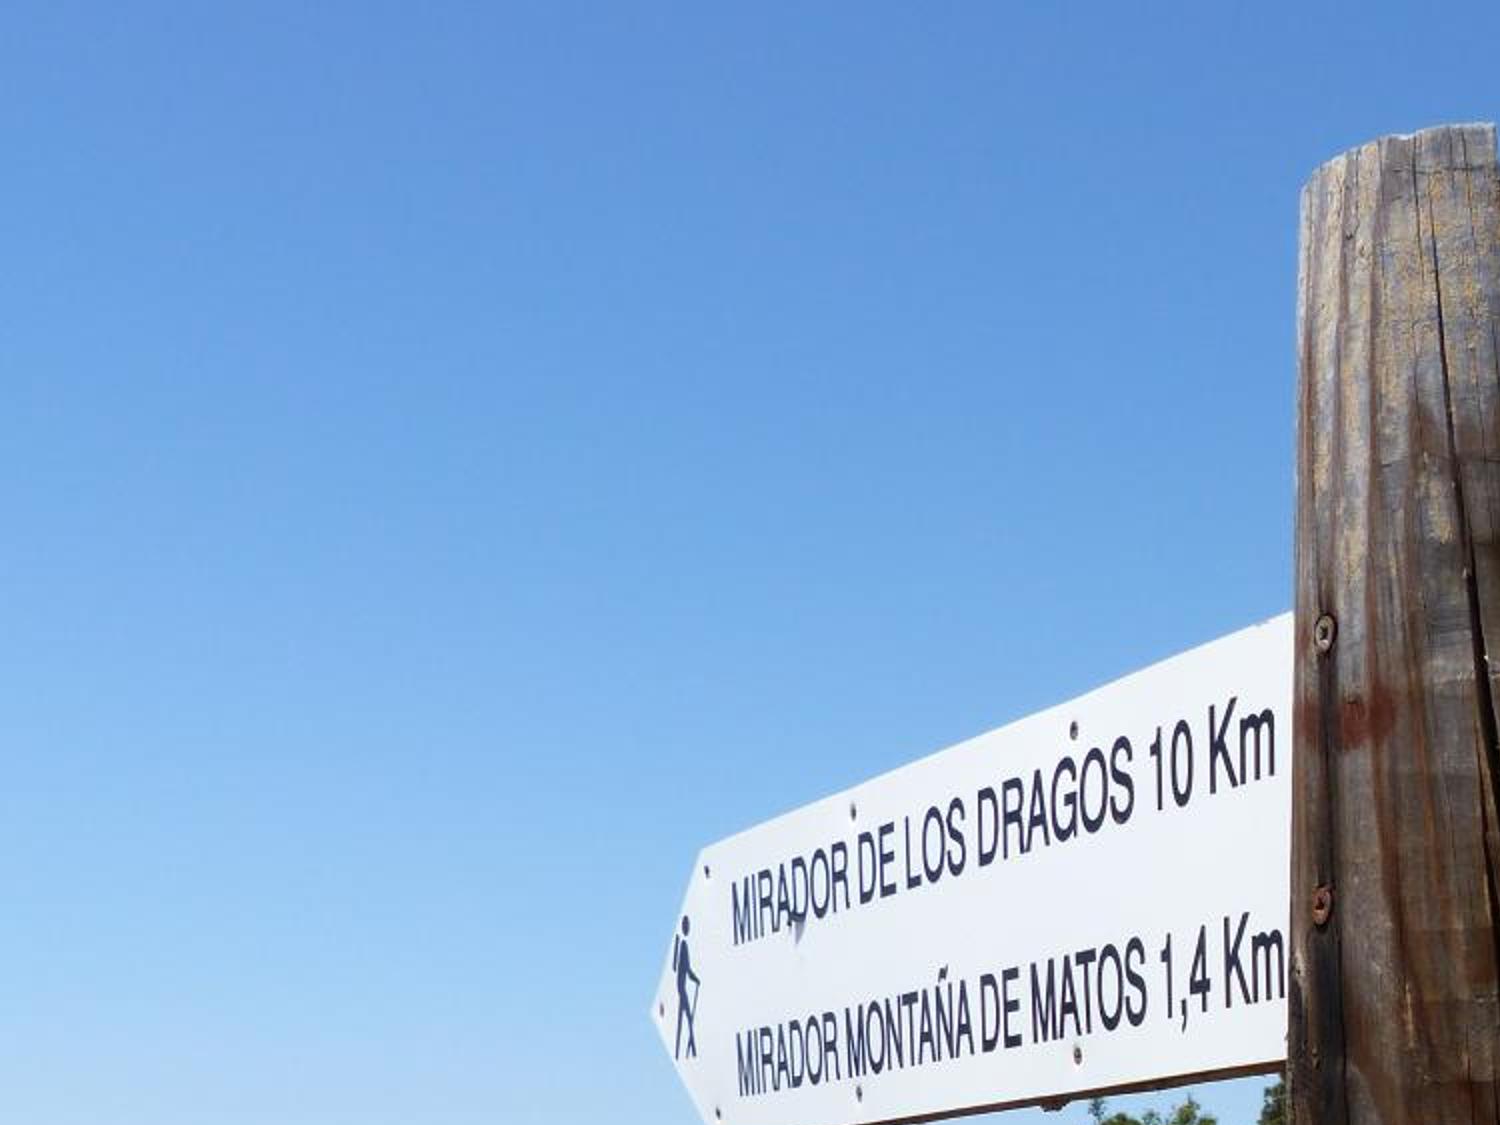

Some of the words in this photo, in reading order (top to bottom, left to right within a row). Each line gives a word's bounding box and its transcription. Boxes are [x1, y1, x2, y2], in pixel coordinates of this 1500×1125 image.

[731, 842, 849, 946] MIRADOR
[858, 821, 896, 905] DE
[905, 797, 967, 890] LOS
[977, 735, 1135, 868] DRAGOS
[1150, 719, 1193, 811] 10
[1208, 697, 1276, 794] Km
[736, 1011, 838, 1097] MIRADOR
[846, 964, 973, 1078] MONTAÑA
[981, 967, 1022, 1053] DE
[1030, 936, 1147, 1043] MATOS
[1160, 925, 1210, 1033] 1,4
[1224, 911, 1286, 1009] Km
